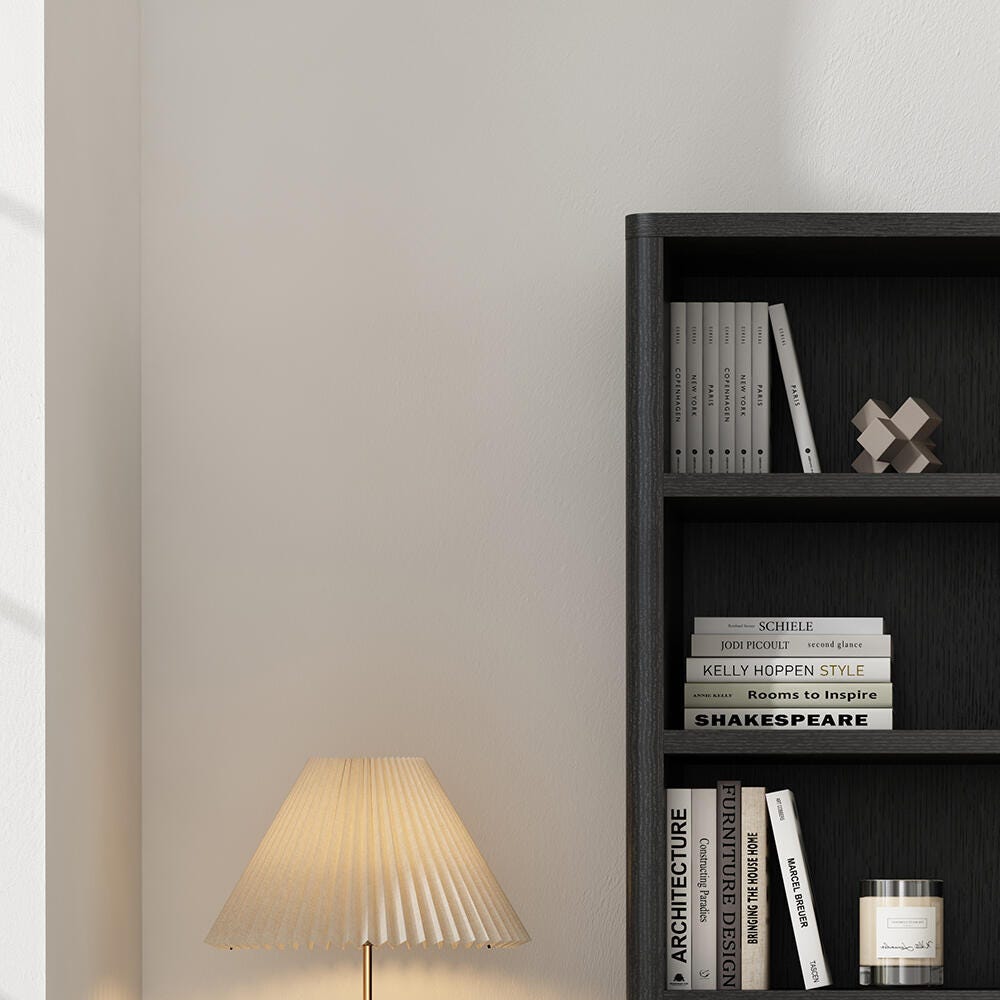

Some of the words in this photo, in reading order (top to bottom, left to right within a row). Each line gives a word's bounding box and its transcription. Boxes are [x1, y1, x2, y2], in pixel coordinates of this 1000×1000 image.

[674, 367, 682, 423] COPENHAGEN
[690, 374, 698, 393] NEW
[690, 395, 698, 417] YORK
[707, 384, 715, 407] PARIS
[790, 384, 801, 407] PARIS
[758, 621, 814, 632] SCHIELE
[720, 640, 744, 651] JODI
[746, 640, 790, 650] PICOULT
[807, 640, 835, 648] second
[837, 640, 863, 650] glance
[703, 664, 749, 677] KELLY
[754, 664, 815, 677] HOPPEN
[819, 664, 865, 677] STYLE
[747, 690, 799, 700] Rooms
[804, 691, 820, 700] to
[825, 690, 878, 702] Inspire
[694, 714, 868, 727] SHAKESPEARE
[722, 784, 736, 905] FURNITURE
[747, 832, 758, 856] HOME
[697, 837, 710, 888] Constructing
[747, 857, 758, 885] HOUSE
[671, 808, 687, 964] ARCHITECTURE
[747, 886, 758, 903] THE
[787, 857, 801, 893] MARCEL
[794, 893, 809, 929] BREUER
[747, 904, 758, 945] BRINGING
[722, 911, 736, 988] DESIGN
